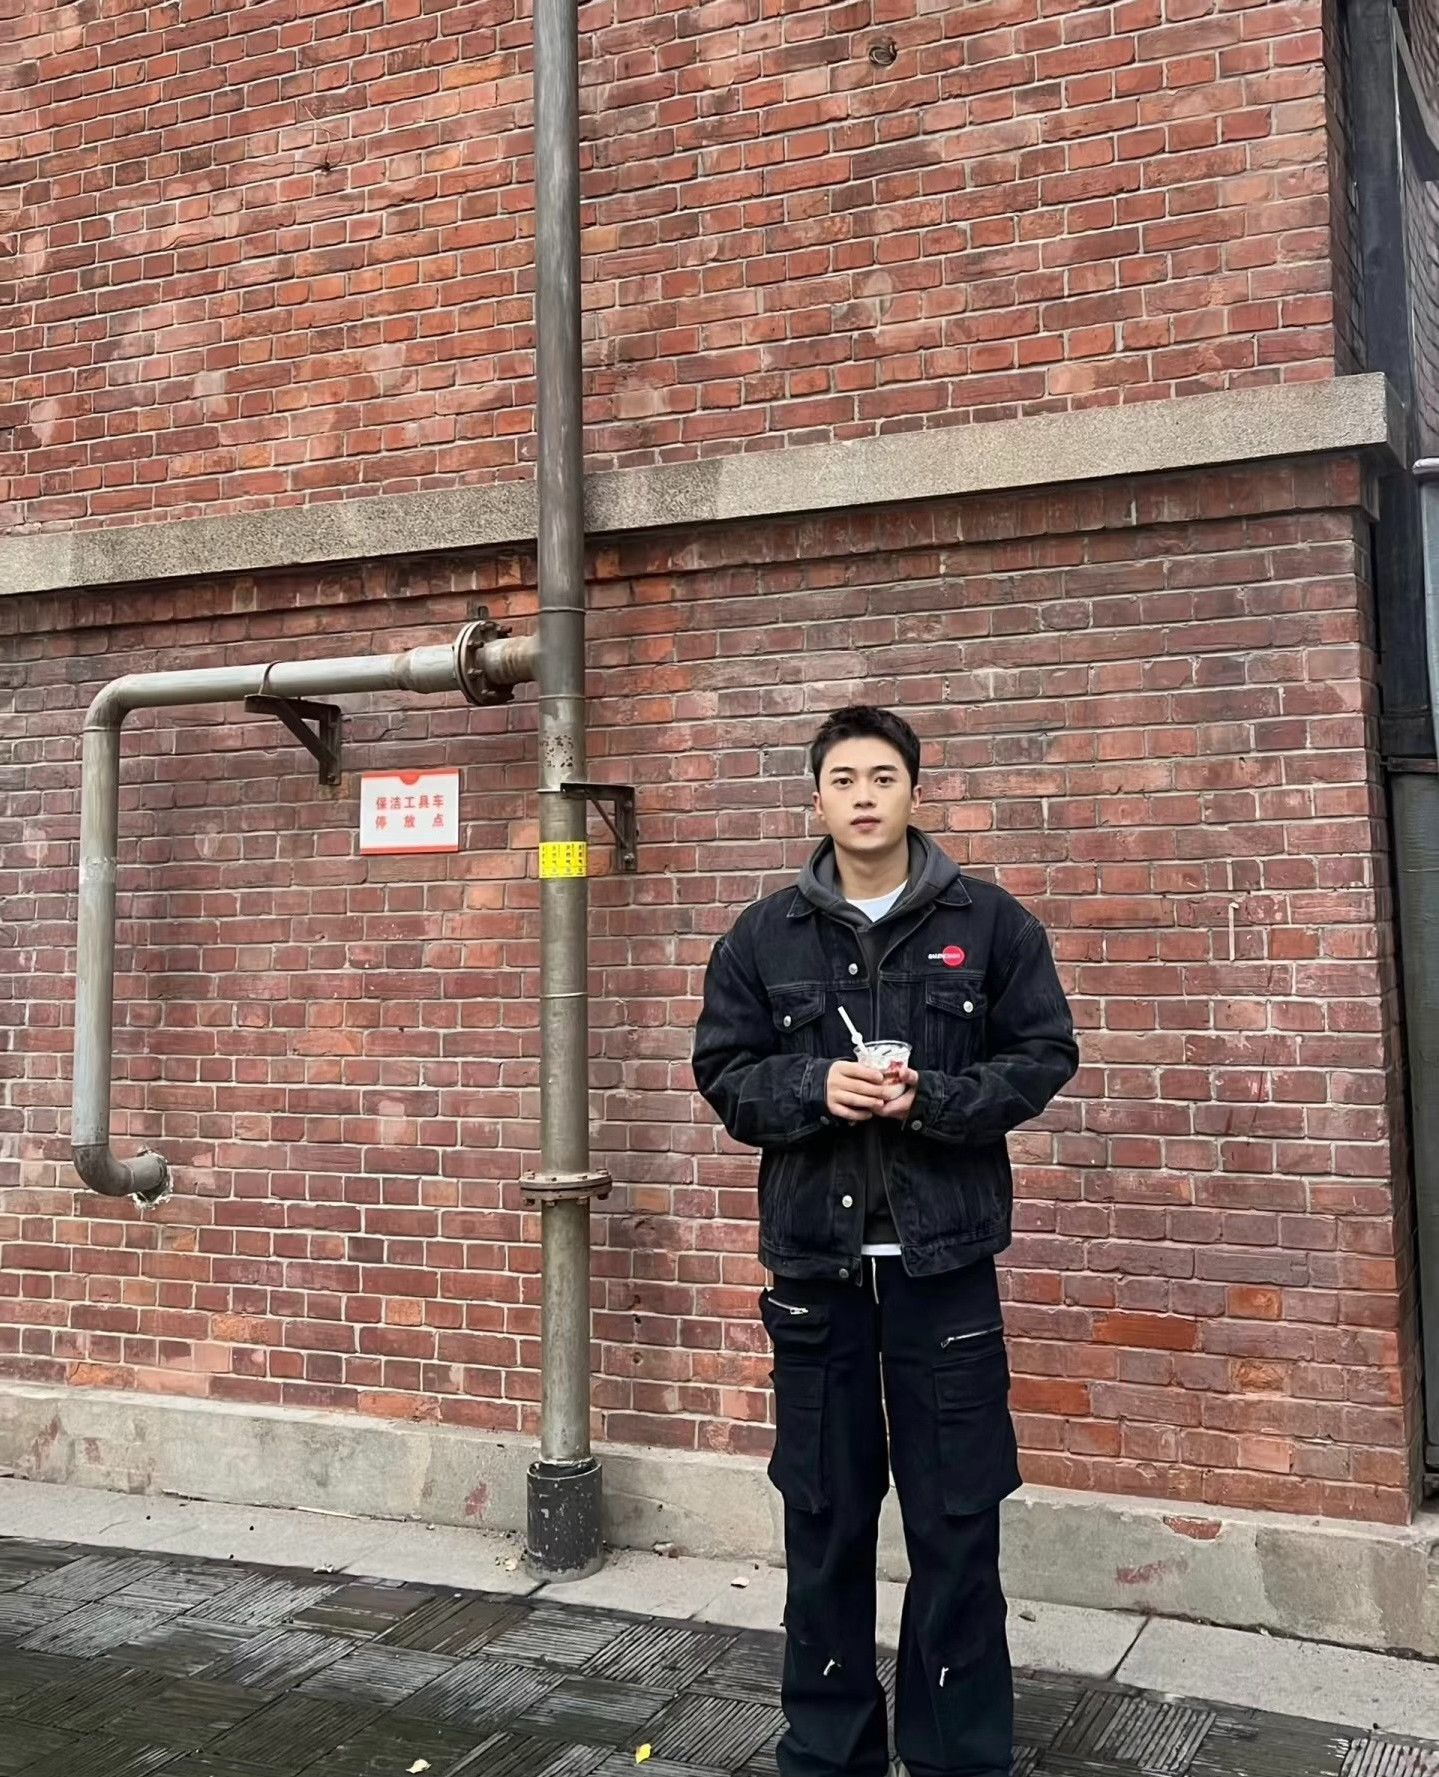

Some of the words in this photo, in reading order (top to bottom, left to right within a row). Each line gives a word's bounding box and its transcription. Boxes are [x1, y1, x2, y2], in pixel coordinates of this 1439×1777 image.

[376, 794, 444, 810] 保洁工具车
[375, 813, 444, 829] 停放点
